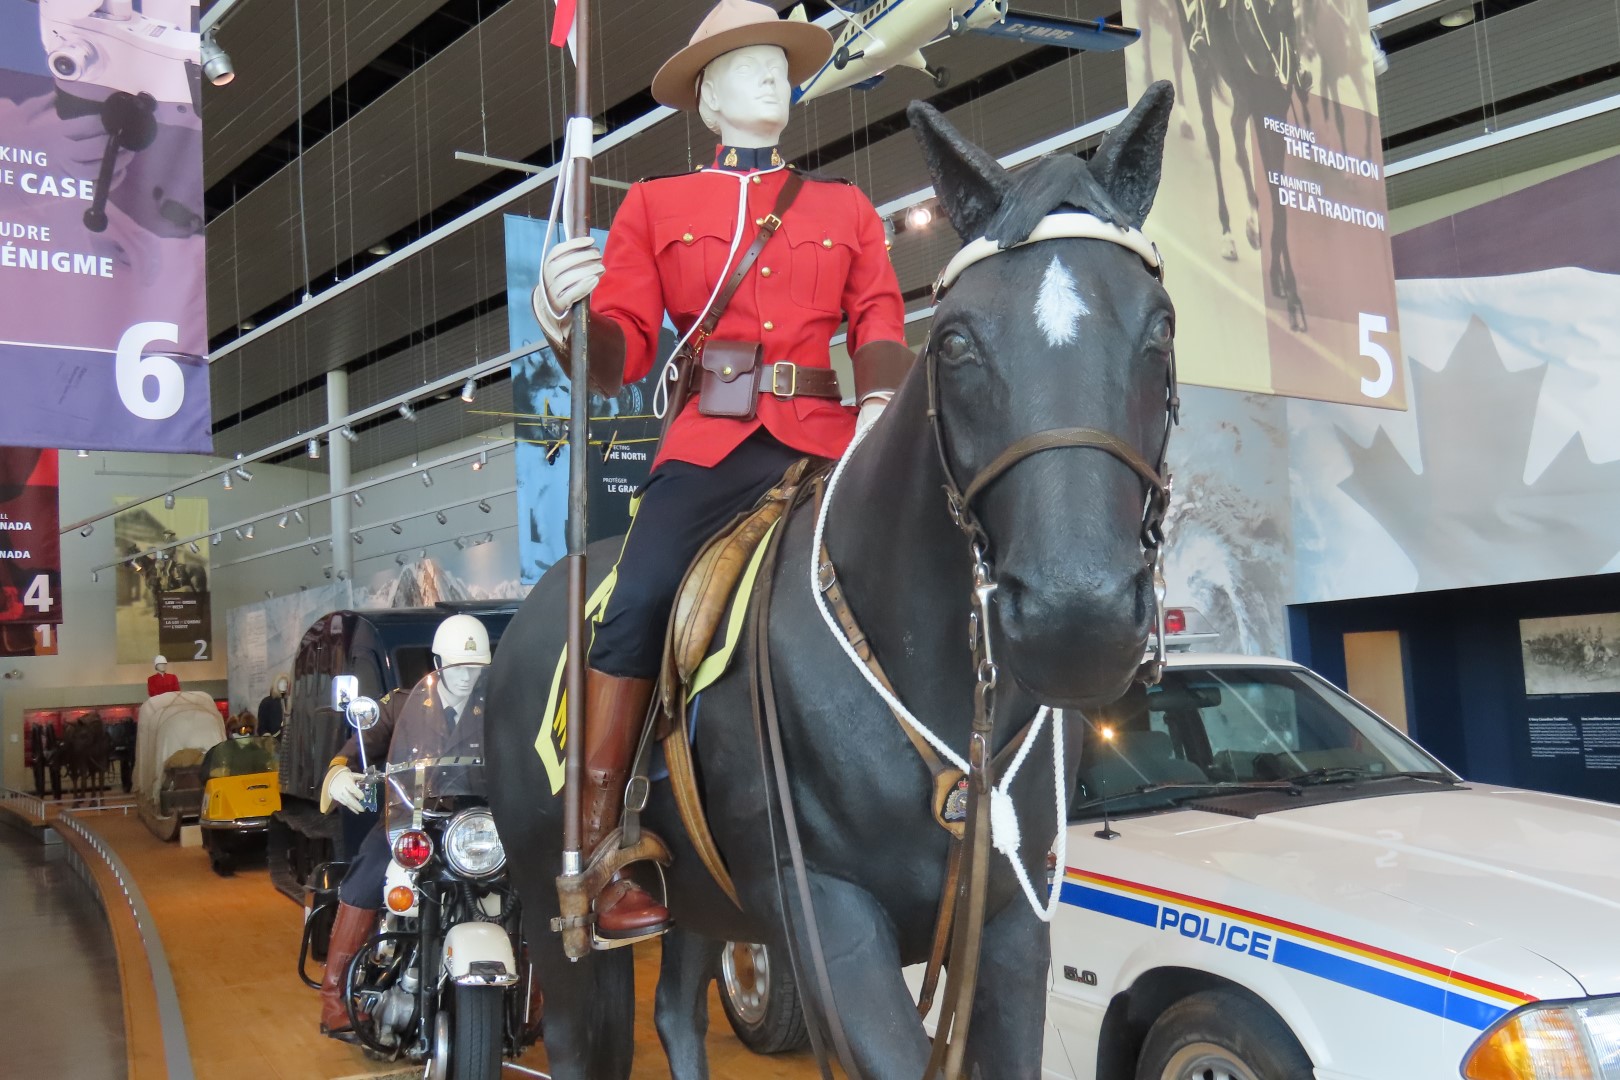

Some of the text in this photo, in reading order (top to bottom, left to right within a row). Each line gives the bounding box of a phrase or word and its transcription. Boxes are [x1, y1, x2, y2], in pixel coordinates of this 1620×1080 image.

[1263, 117, 1316, 144] PRESERVING
[0, 146, 47, 167] KING
[1284, 136, 1379, 181] THE TRADITION
[0, 169, 94, 201] E CASE
[1268, 171, 1322, 196] LE MAINTIEN
[1278, 187, 1385, 231] DE LA TRADITION
[1, 241, 114, 278] ÉNIGME
[1359, 312, 1394, 398] 5
[115, 321, 185, 420] 6
[610, 451, 646, 460] HE NORTH
[0, 521, 32, 531] NADA
[0, 550, 31, 559] NADA
[23, 574, 53, 612] 4
[35, 623, 51, 648] 1
[194, 639, 208, 660] 2
[1160, 906, 1272, 960] POLICE
